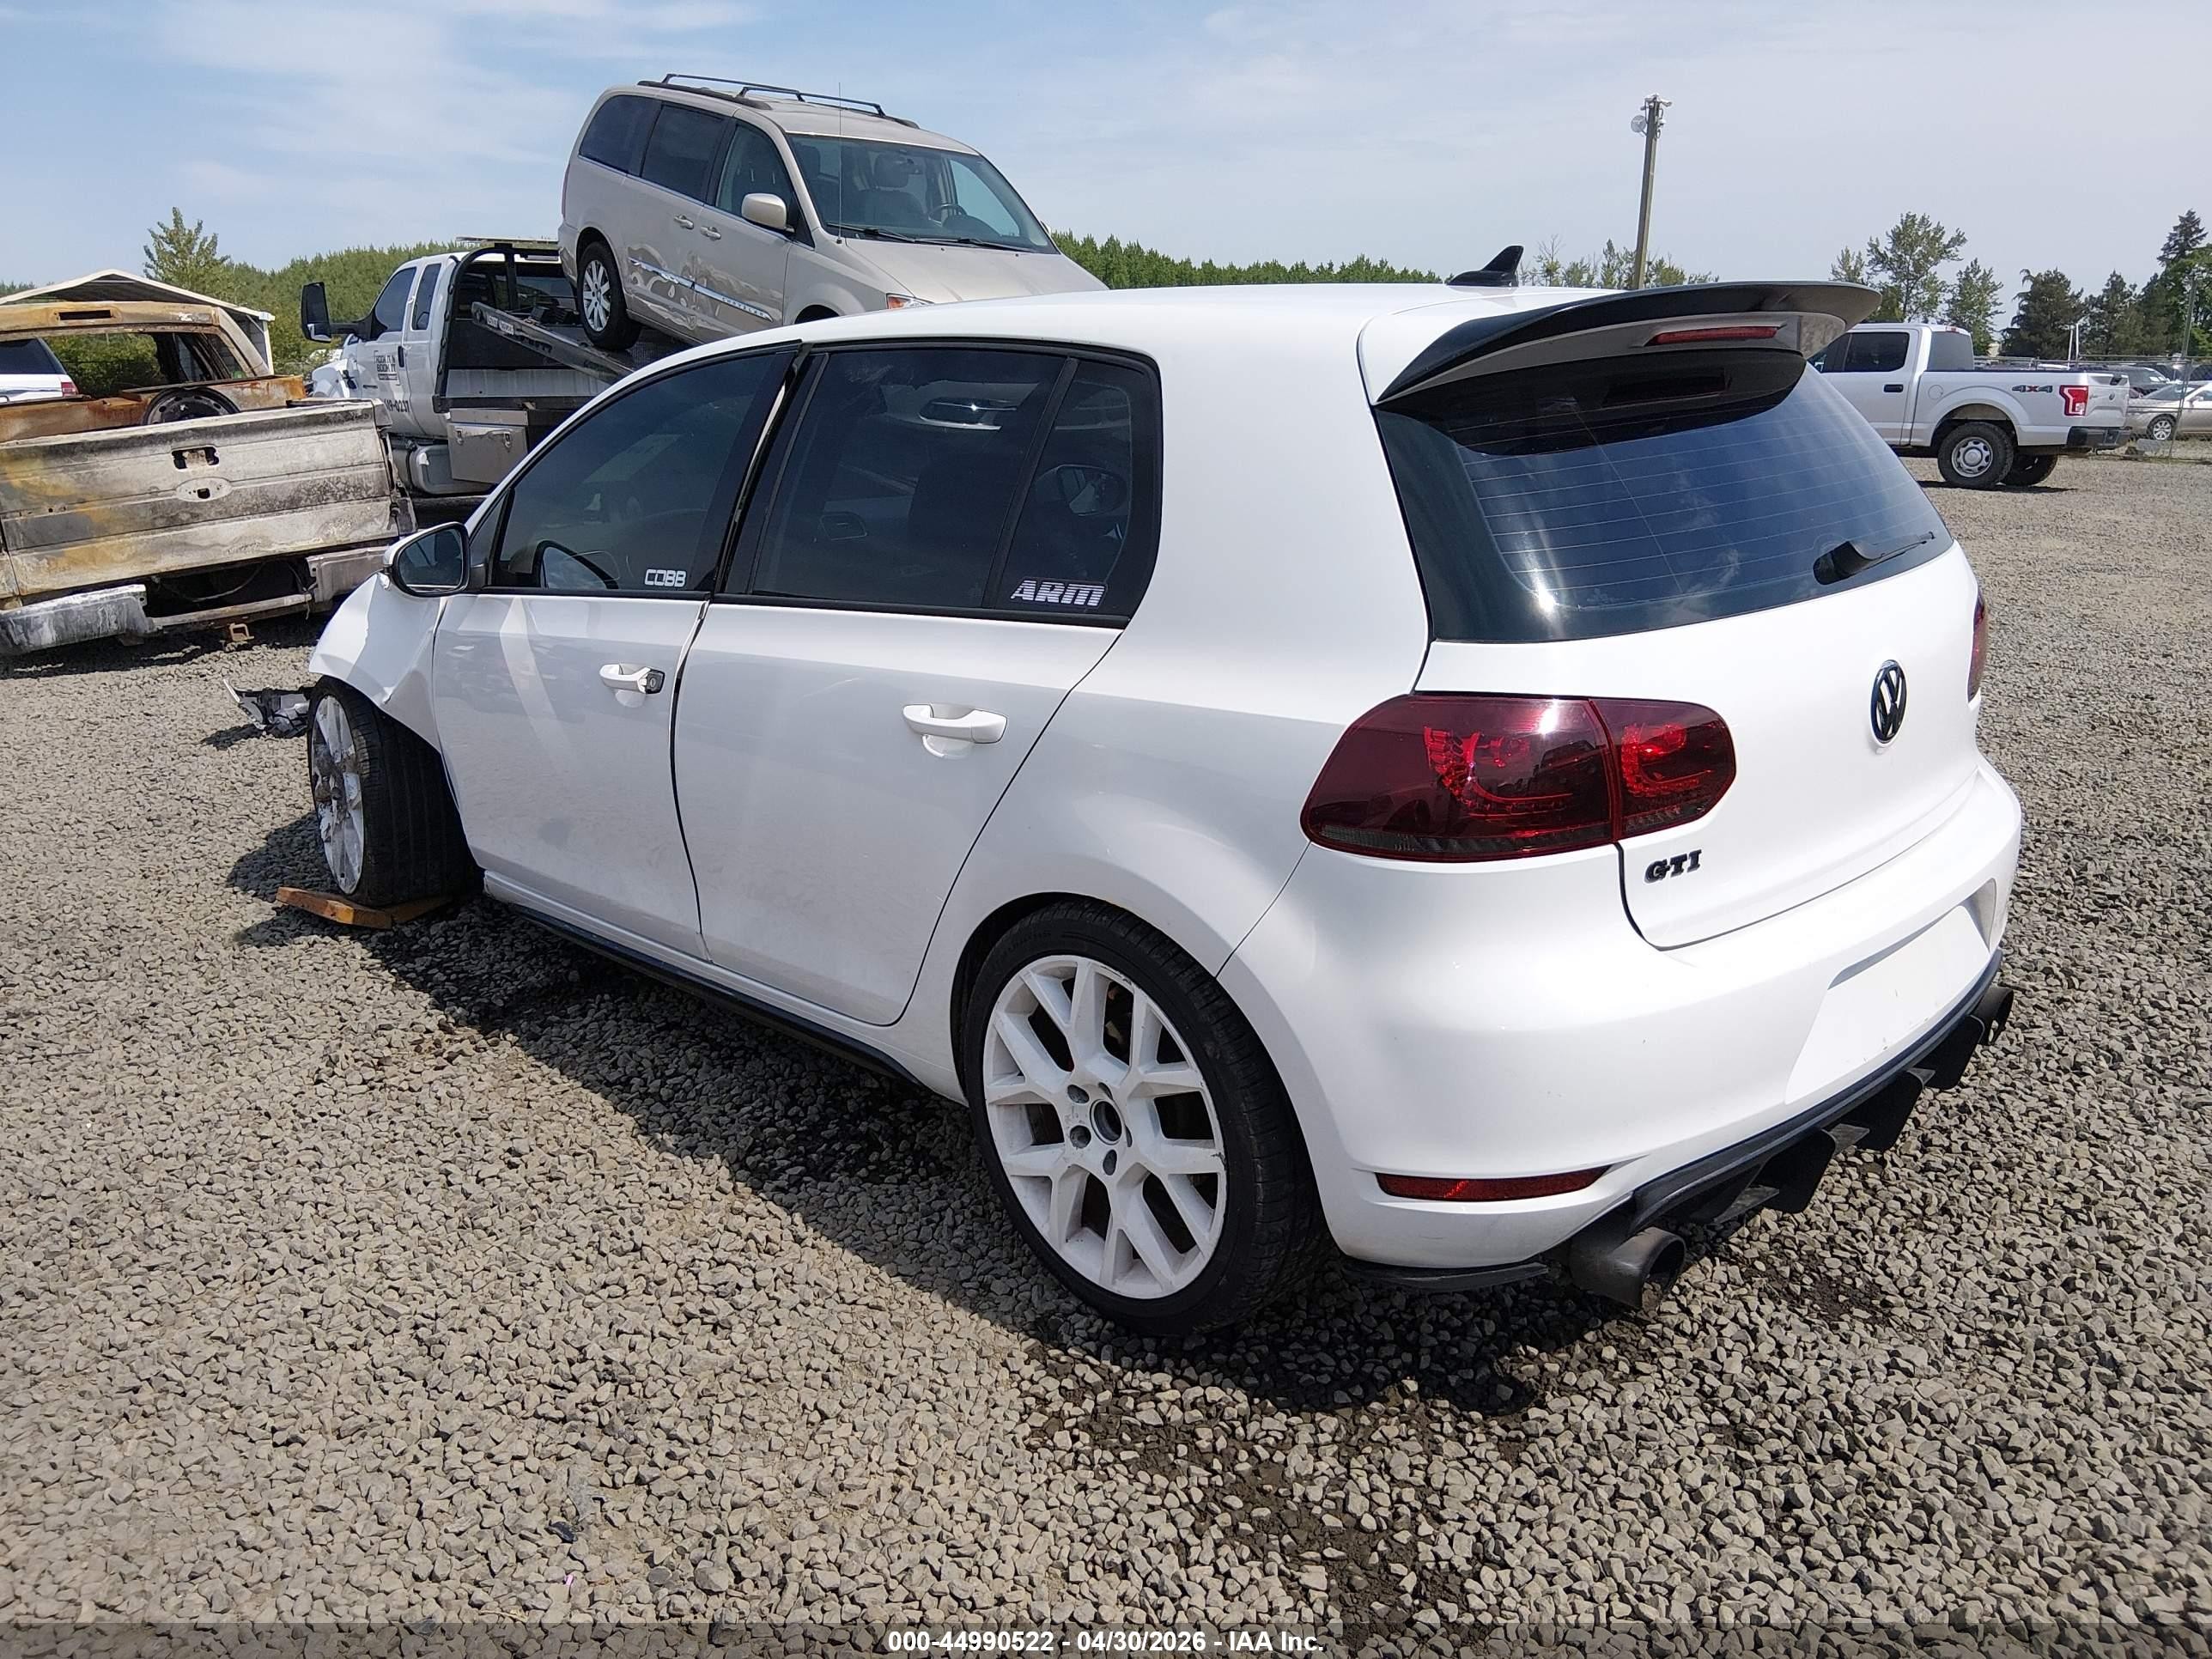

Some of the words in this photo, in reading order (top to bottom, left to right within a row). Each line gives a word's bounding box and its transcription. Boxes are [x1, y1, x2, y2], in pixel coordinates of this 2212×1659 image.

[644, 568, 687, 587] COBB
[1010, 580, 1105, 606] ARM
[1871, 659, 1907, 744] VW
[1644, 849, 1702, 884] GTI
